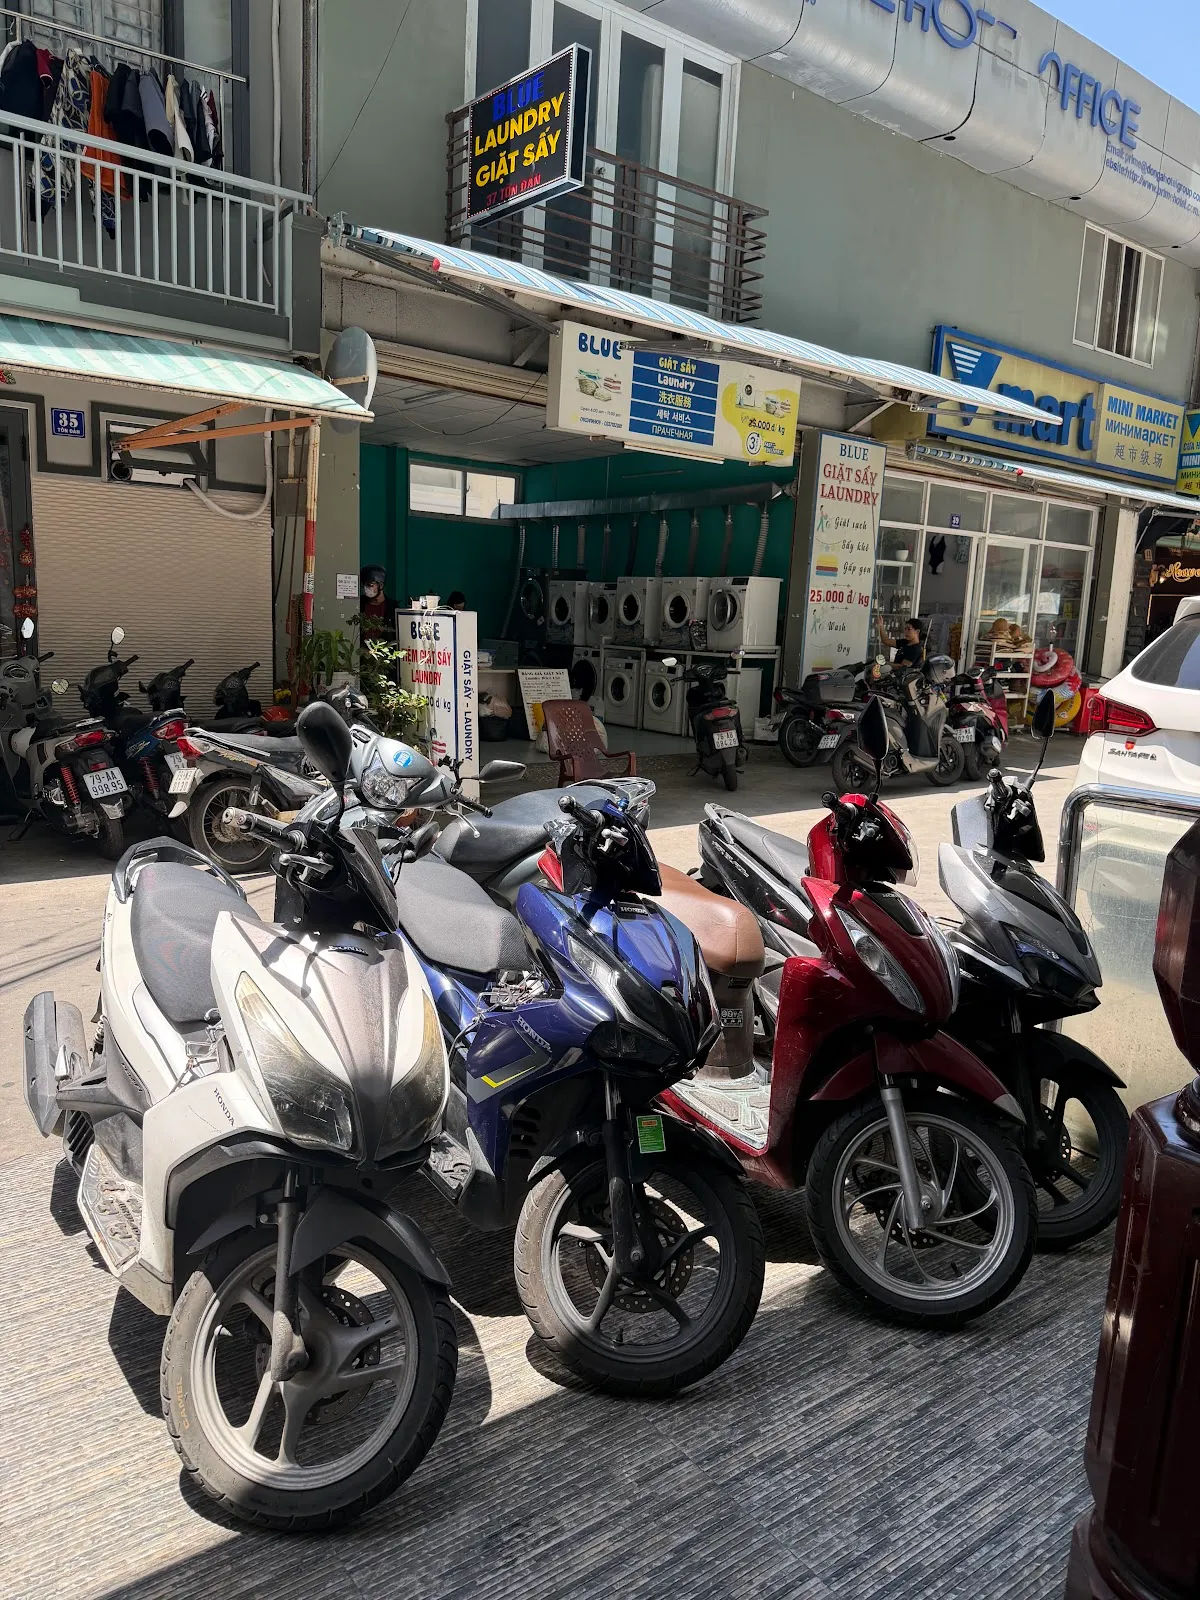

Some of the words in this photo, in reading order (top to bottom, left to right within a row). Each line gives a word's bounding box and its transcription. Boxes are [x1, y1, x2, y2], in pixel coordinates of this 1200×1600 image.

[492, 71, 544, 122] BLUE
[475, 91, 565, 157] LAUNDRY
[475, 150, 519, 187] GIẶT
[523, 126, 561, 167] SẤY
[578, 332, 622, 360] BLUE
[659, 356, 678, 371] GIẶT
[680, 359, 697, 375] SẤY
[657, 373, 695, 392] Laundry
[59, 413, 78, 427] 35
[656, 408, 670, 421] 세탁
[671, 411, 692, 424] 서비스
[1107, 395, 1134, 418] MINI
[1135, 404, 1179, 430] MARKET
[651, 424, 693, 440] ПРАЧЕЧНАЯ
[840, 443, 869, 461] BLUE
[823, 462, 854, 485] GIẶT
[854, 465, 878, 487] SẤY
[820, 483, 880, 506] LAUNDRY
[810, 589, 844, 604] 25.000
[858, 592, 870, 607] kg
[828, 620, 847, 632] Wash
[437, 646, 451, 666] SẤY
[461, 650, 473, 677] GIẶT
[411, 669, 441, 686] LAUNDRY
[463, 679, 474, 699] SẤY
[443, 699, 451, 712] kg
[464, 711, 473, 761] LAUNDRY
[90, 771, 117, 785] 79-AA
[92, 780, 124, 796] 998.95
[517, 1014, 552, 1053] HONDA
[214, 1087, 234, 1127] HONDA
